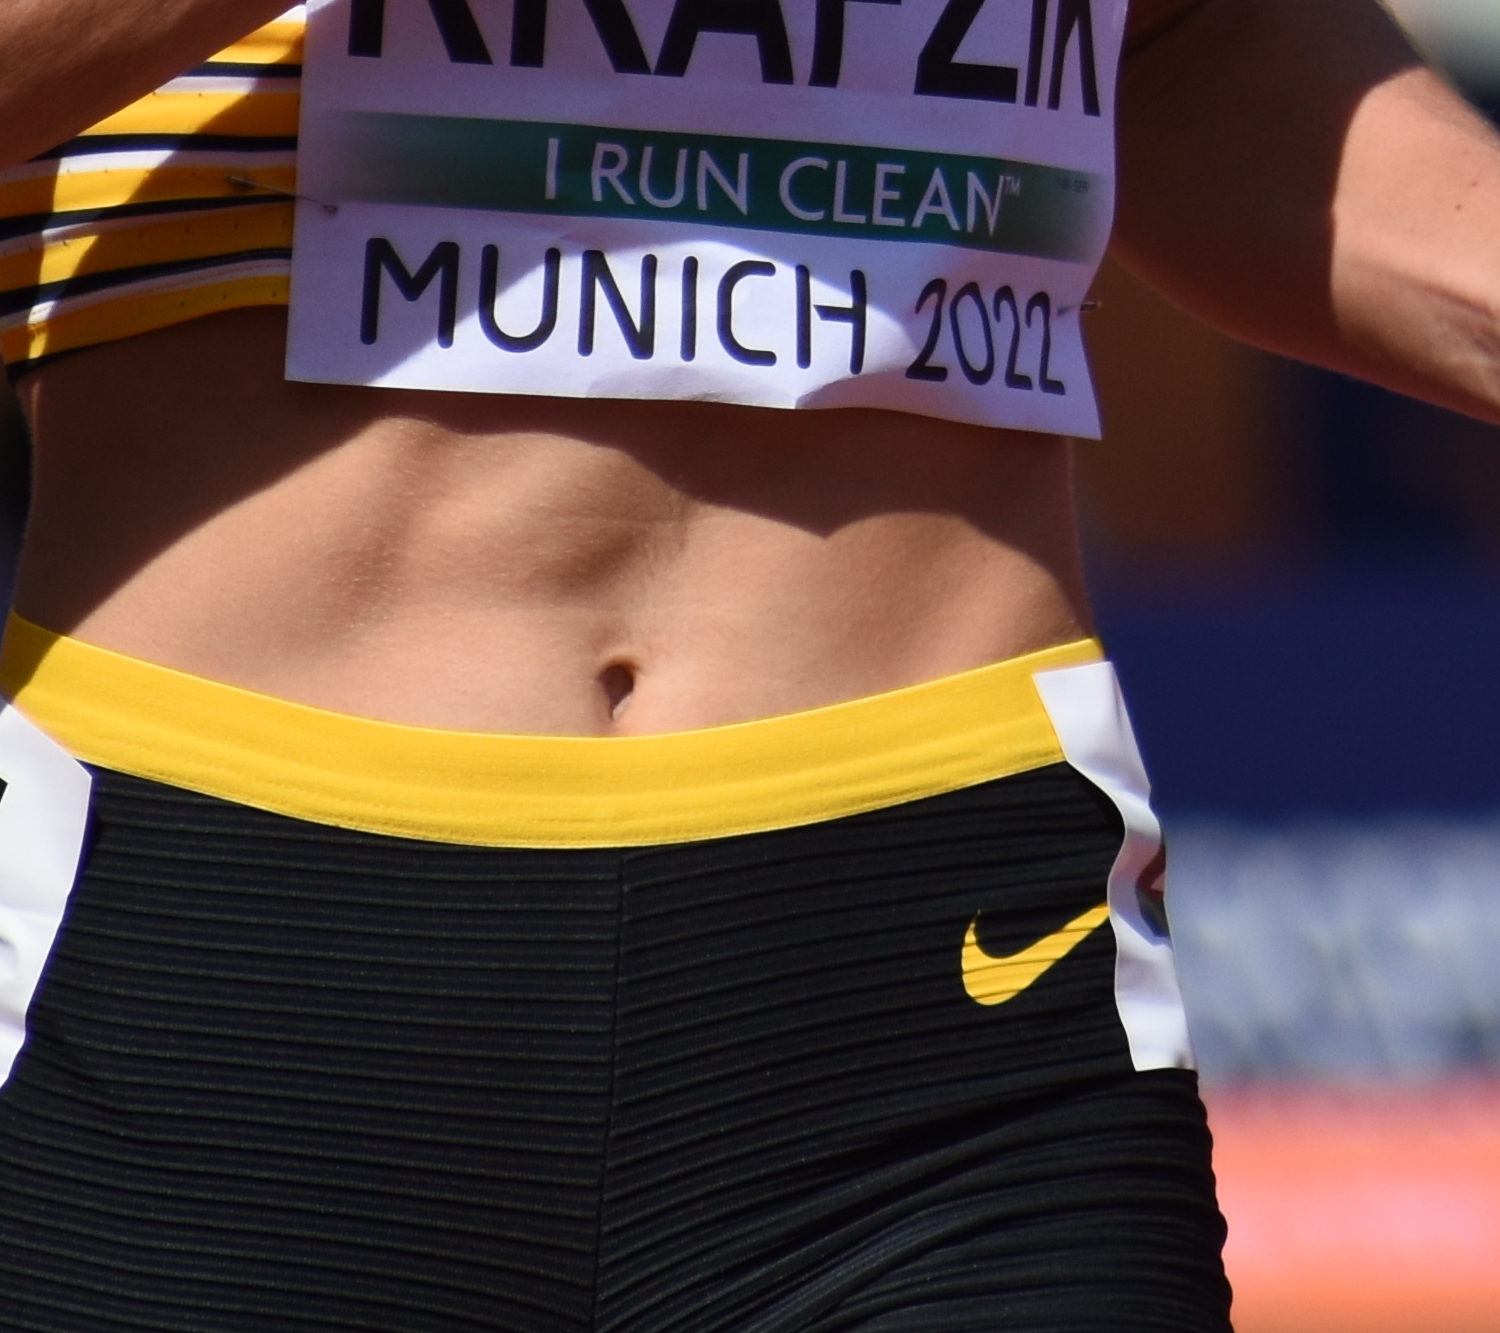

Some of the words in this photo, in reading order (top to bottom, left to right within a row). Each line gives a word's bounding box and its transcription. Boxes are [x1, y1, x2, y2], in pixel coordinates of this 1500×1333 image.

[545, 138, 559, 200] I
[591, 142, 749, 216] RUN
[360, 238, 866, 375] MUNICH
[905, 278, 1065, 395] 2022
